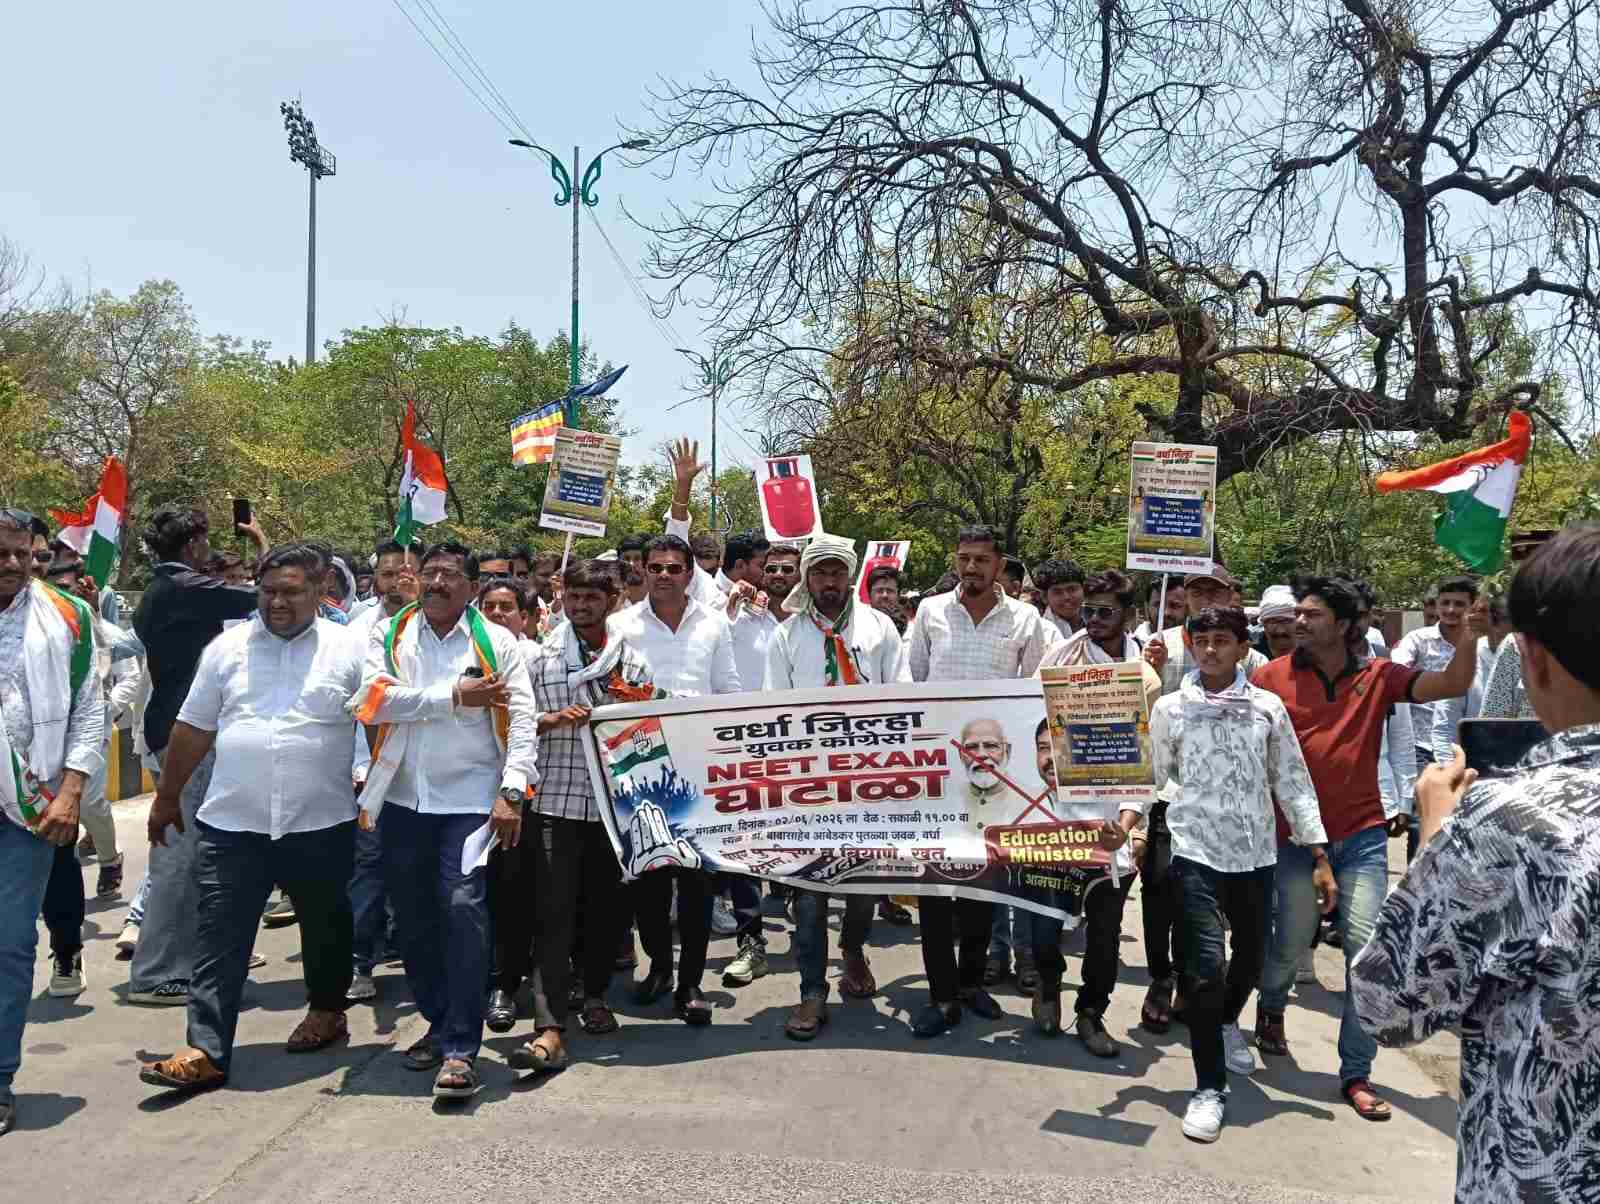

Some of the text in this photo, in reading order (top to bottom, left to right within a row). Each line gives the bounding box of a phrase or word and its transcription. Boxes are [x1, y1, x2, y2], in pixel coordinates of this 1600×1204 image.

[713, 711, 925, 741] वर्धा जिल्हा
[745, 738, 813, 758] युवक
[707, 749, 947, 783] NEET EXAM
[703, 769, 950, 814] घोटाळा
[888, 810, 921, 823] सकाळी
[1000, 827, 1099, 847] Education
[1010, 845, 1093, 863] Minister
